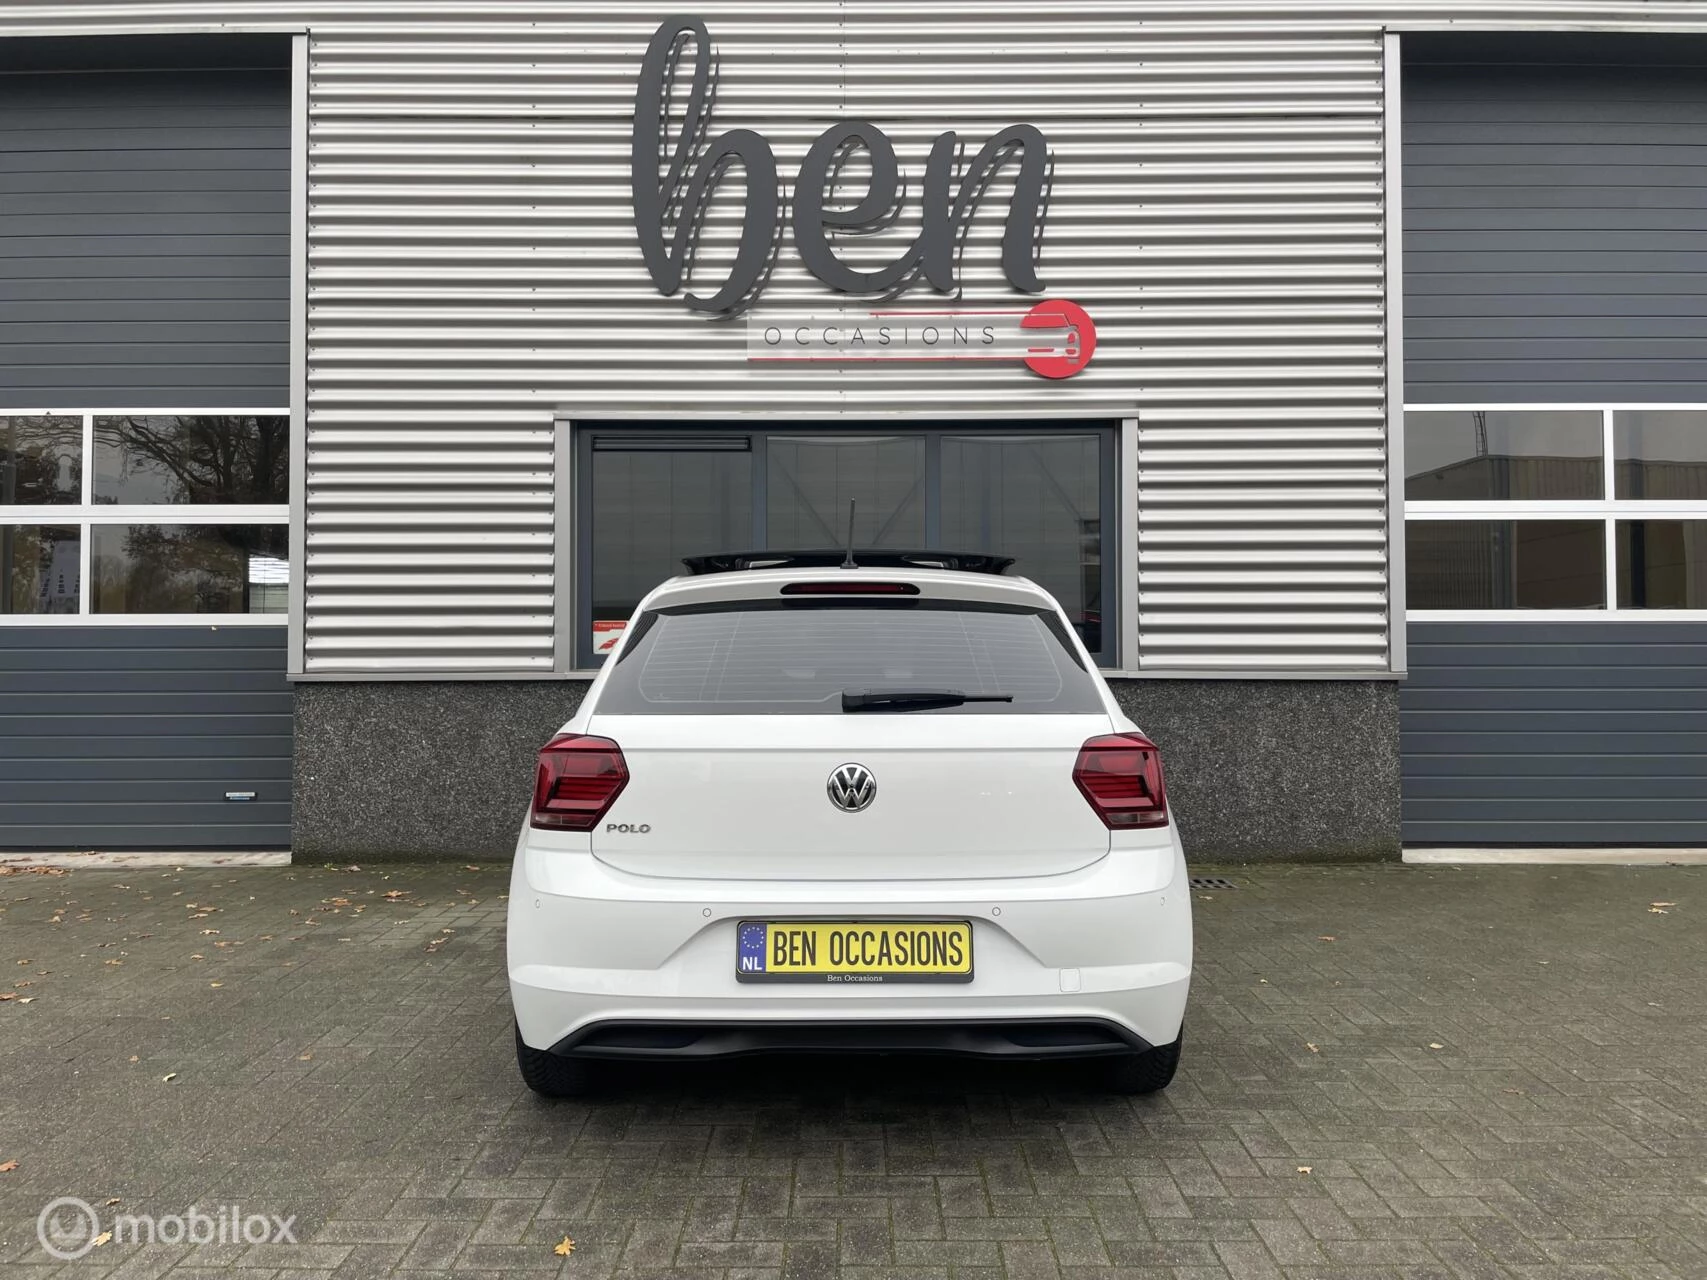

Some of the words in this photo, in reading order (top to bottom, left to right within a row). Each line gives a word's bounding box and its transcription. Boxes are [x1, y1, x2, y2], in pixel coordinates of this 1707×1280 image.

[631, 15, 1047, 312] ben
[764, 325, 995, 346] OCCASIONS
[606, 823, 652, 834] POLO
[773, 930, 817, 966] BEN
[829, 930, 964, 967] OCCASIONS
[742, 956, 763, 971] NL
[827, 974, 842, 982] Ben
[844, 974, 883, 982] Occasions
